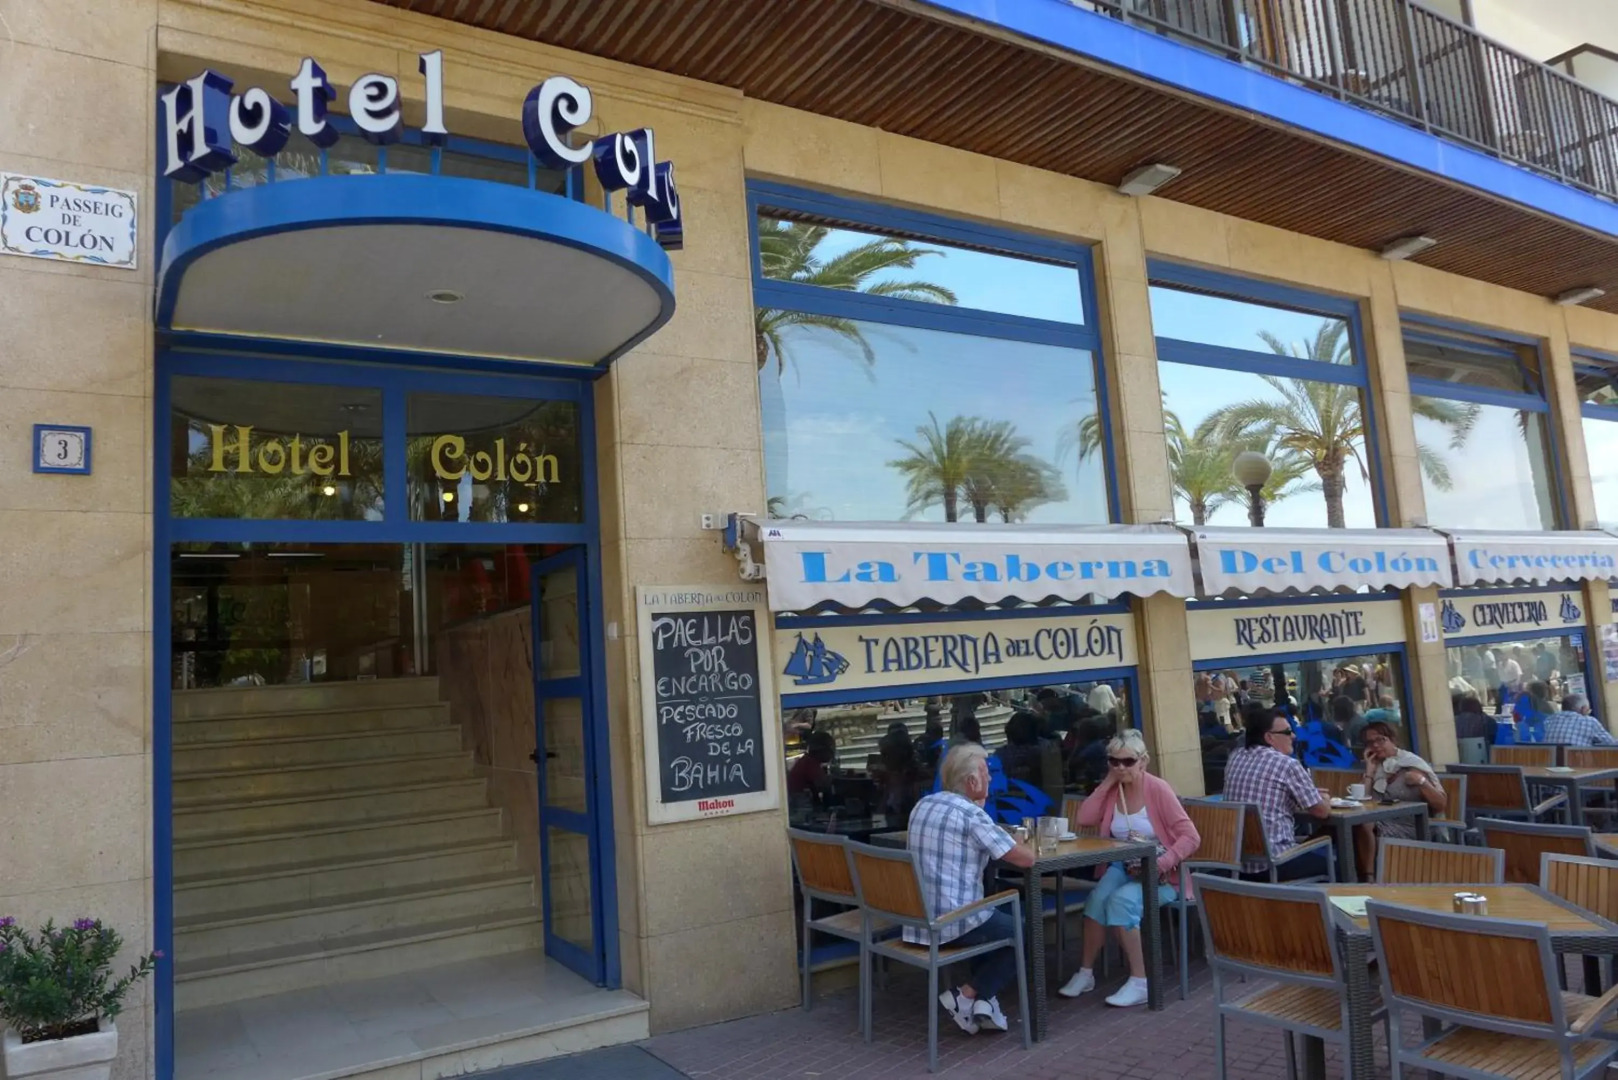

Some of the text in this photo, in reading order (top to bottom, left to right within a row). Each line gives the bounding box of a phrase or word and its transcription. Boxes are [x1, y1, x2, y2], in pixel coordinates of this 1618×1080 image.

[161, 49, 449, 176] Hotel
[49, 194, 124, 219] PASSEIG
[61, 213, 82, 227] DE
[25, 225, 115, 253] COLÓN
[57, 439, 69, 461] 3
[207, 423, 561, 484] Hotel Colón
[798, 551, 1173, 584] La Taberna
[1219, 549, 1440, 575] Del Colón
[652, 614, 753, 650] PAELLAS
[1234, 609, 1366, 650] RESTAURANTE
[684, 645, 729, 673] POR
[858, 631, 1004, 675] TABERNA
[1034, 619, 1124, 663] COLÓN
[657, 670, 753, 698] ENCARGO
[660, 703, 738, 725] PESCADO
[682, 722, 743, 743] FRESCO
[708, 738, 754, 756] DE LA
[670, 756, 750, 791] BAHÍA
[698, 799, 735, 811] Mahou
